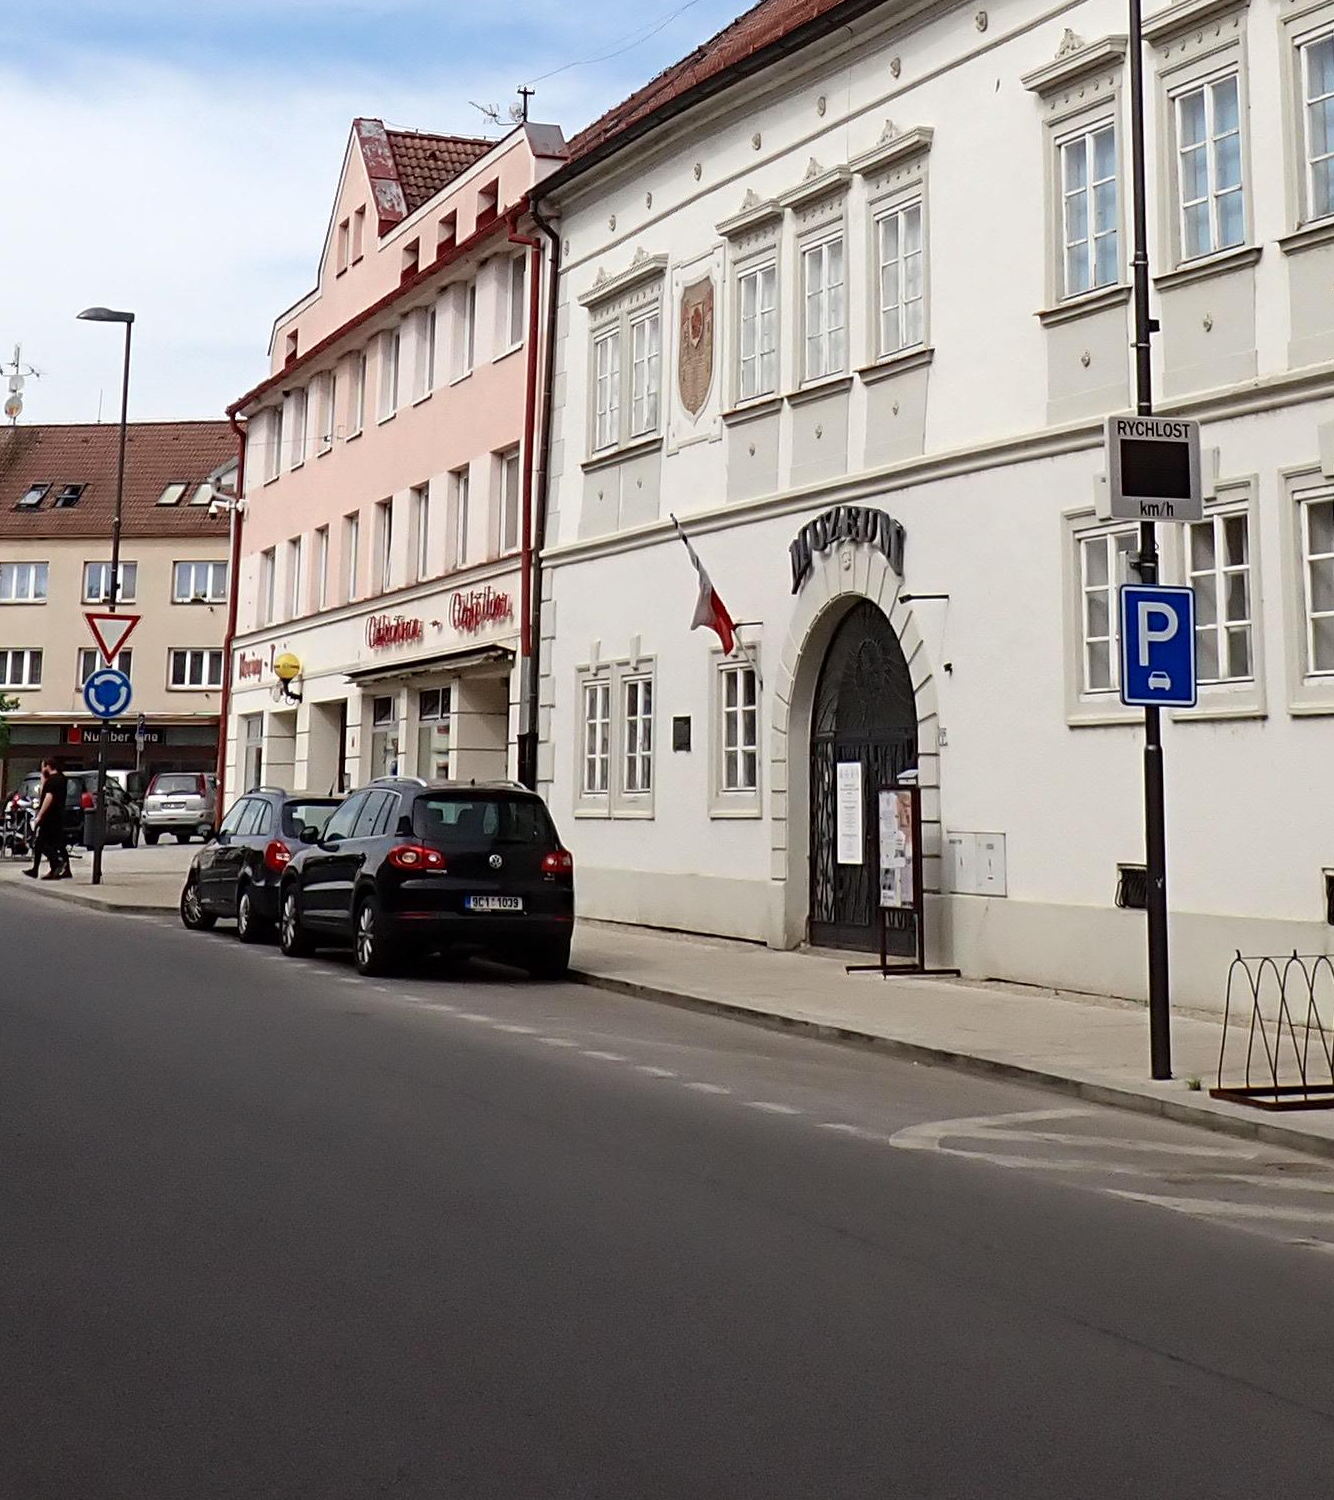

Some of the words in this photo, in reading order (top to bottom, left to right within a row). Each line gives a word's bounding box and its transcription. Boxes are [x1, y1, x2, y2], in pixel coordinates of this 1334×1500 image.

[1117, 420, 1190, 438] RYCHLOST
[1140, 501, 1174, 516] km/h
[789, 505, 906, 596] MUZEUM
[1137, 601, 1179, 667] P
[83, 730, 130, 742] Nuber
